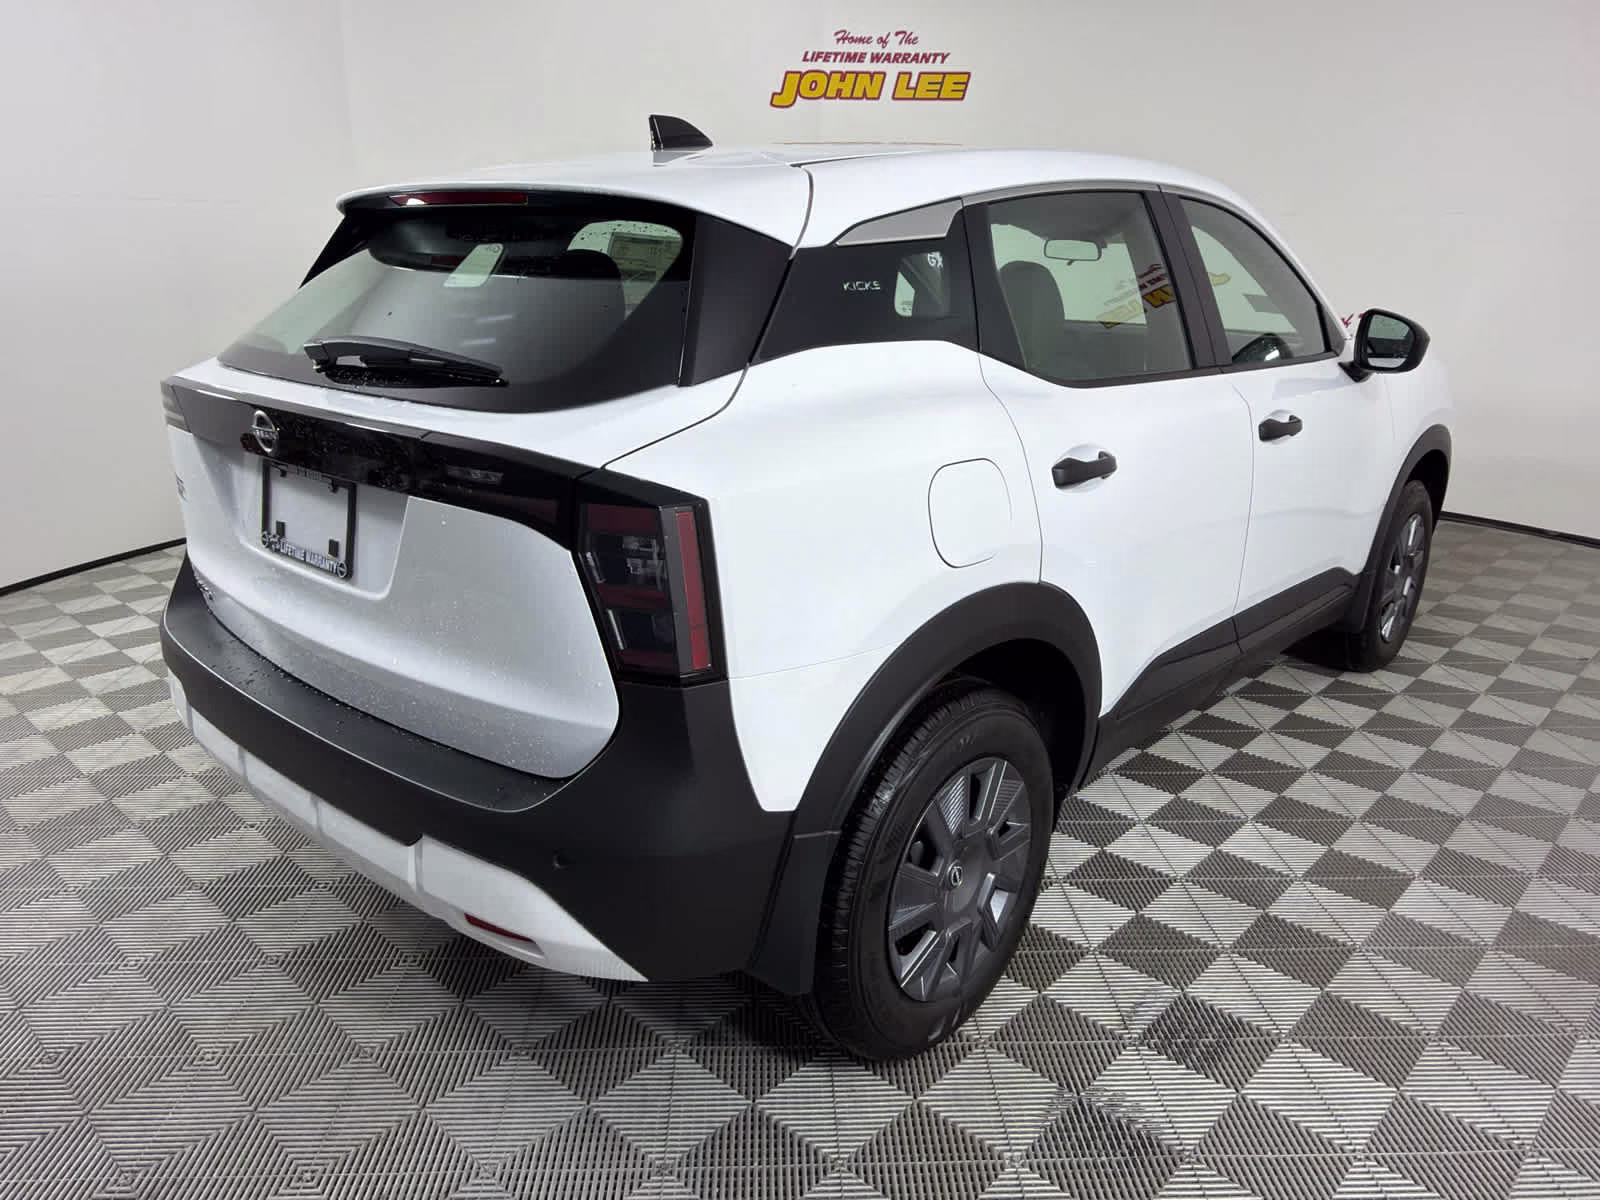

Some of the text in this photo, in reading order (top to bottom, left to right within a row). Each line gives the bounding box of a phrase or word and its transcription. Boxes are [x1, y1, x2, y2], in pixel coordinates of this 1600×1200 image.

[833, 29, 919, 49] Home of The
[802, 50, 951, 64] LIFETIME WARRANTY
[770, 70, 971, 108] JOHN LEE
[843, 280, 881, 291] KICKS
